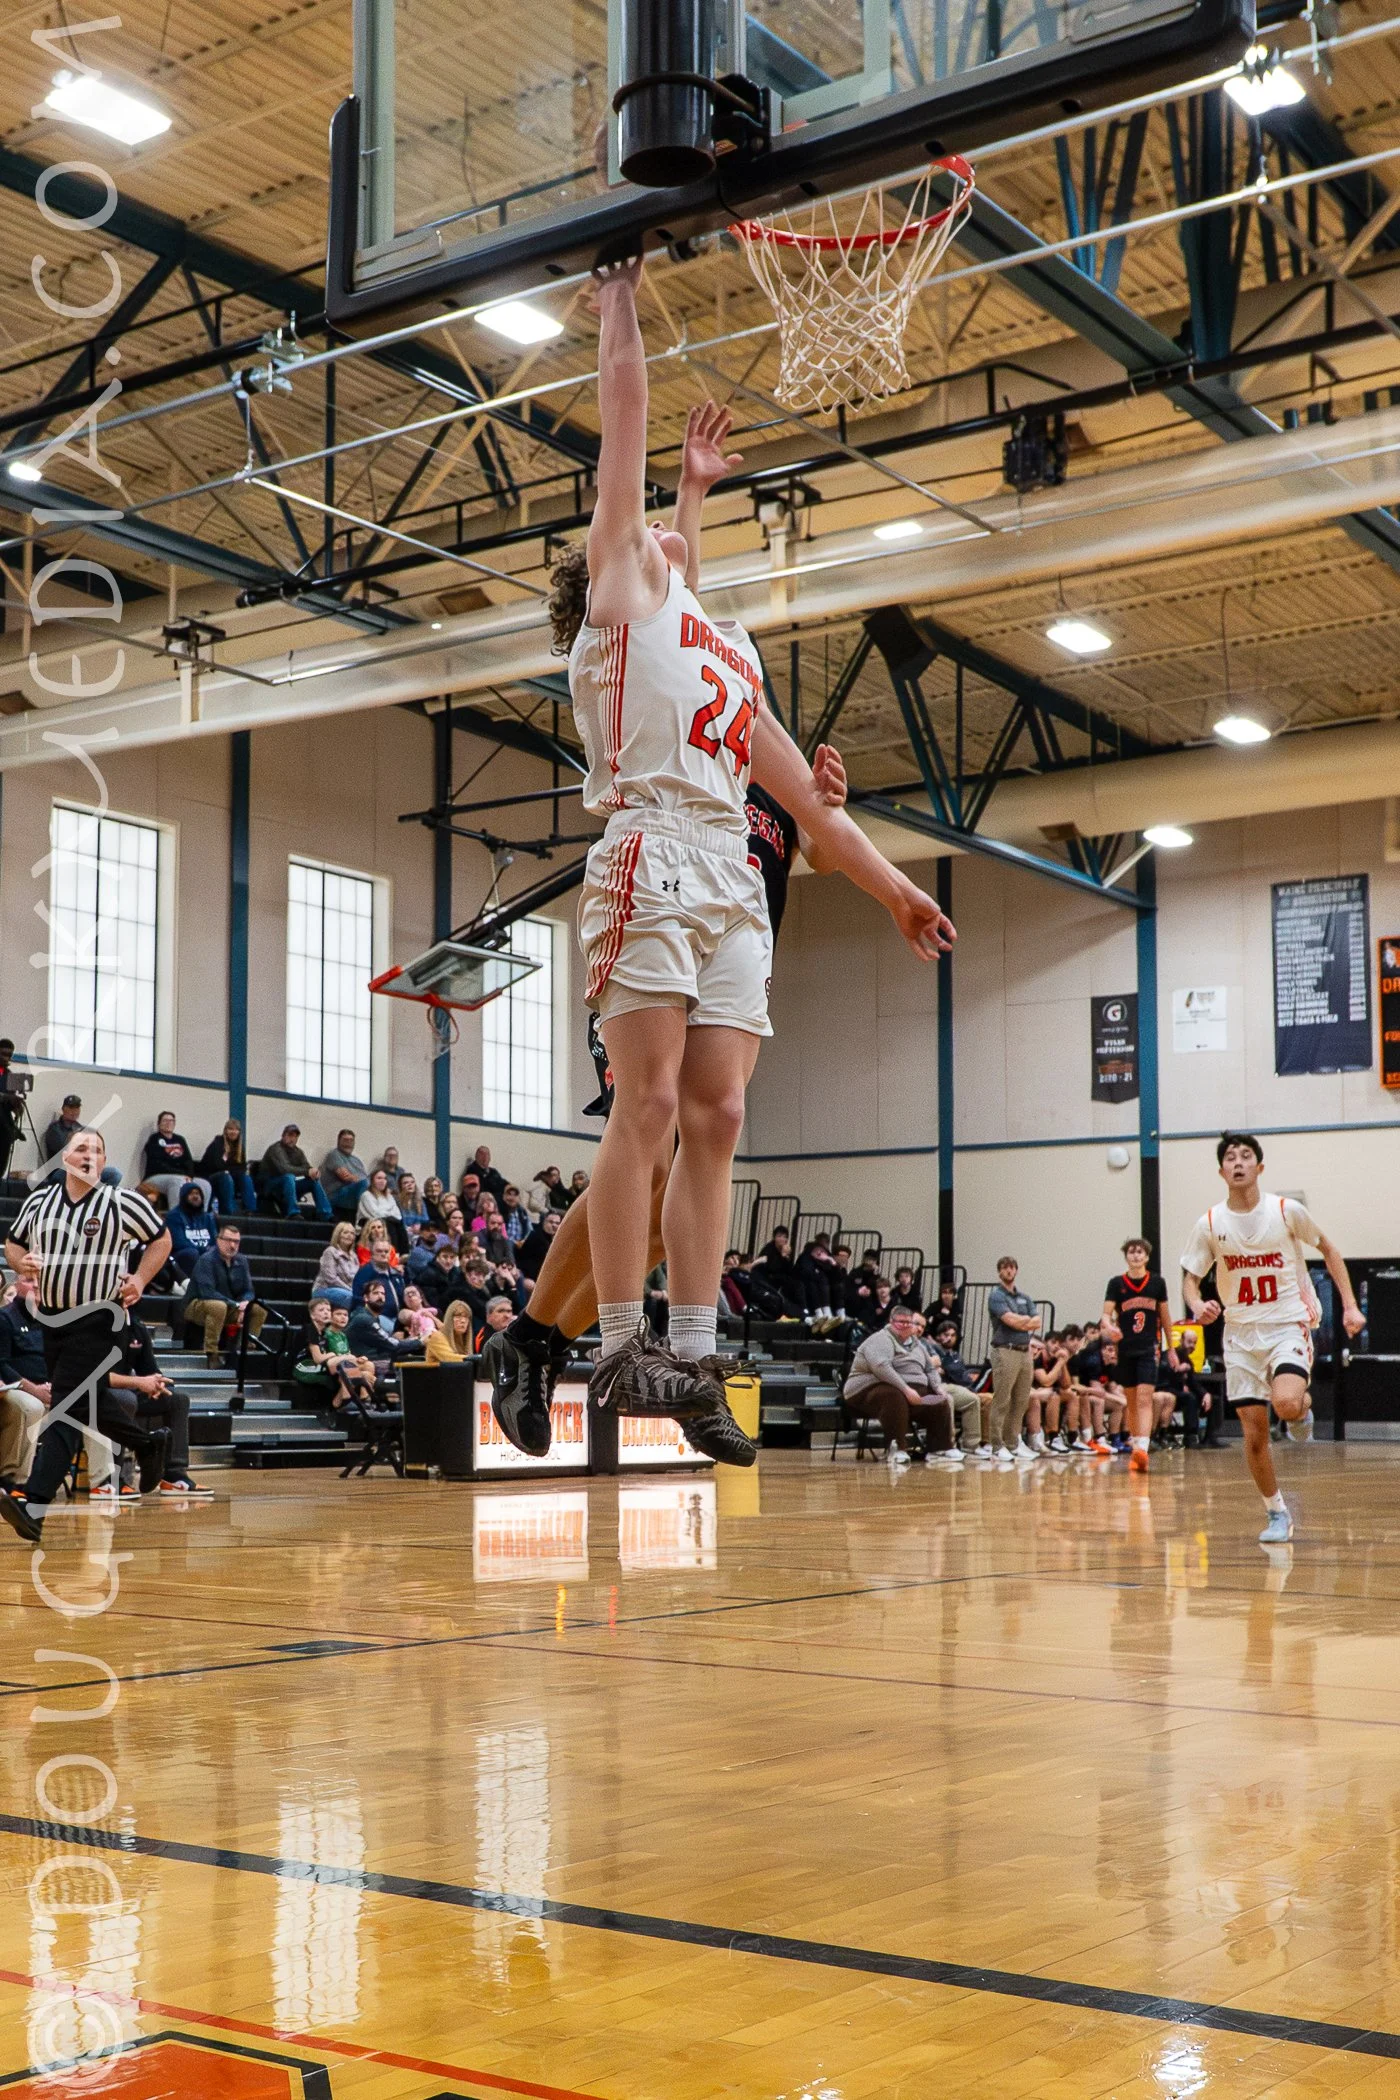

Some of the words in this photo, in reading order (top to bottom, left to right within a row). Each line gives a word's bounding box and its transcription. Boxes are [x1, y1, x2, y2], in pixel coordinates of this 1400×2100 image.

[687, 664, 750, 779] 24
[1223, 1251, 1284, 1272] DRAGONS
[1238, 1274, 1278, 1307] 40
[1132, 1311, 1146, 1333] 3
[500, 1449, 522, 1462] HIGH
